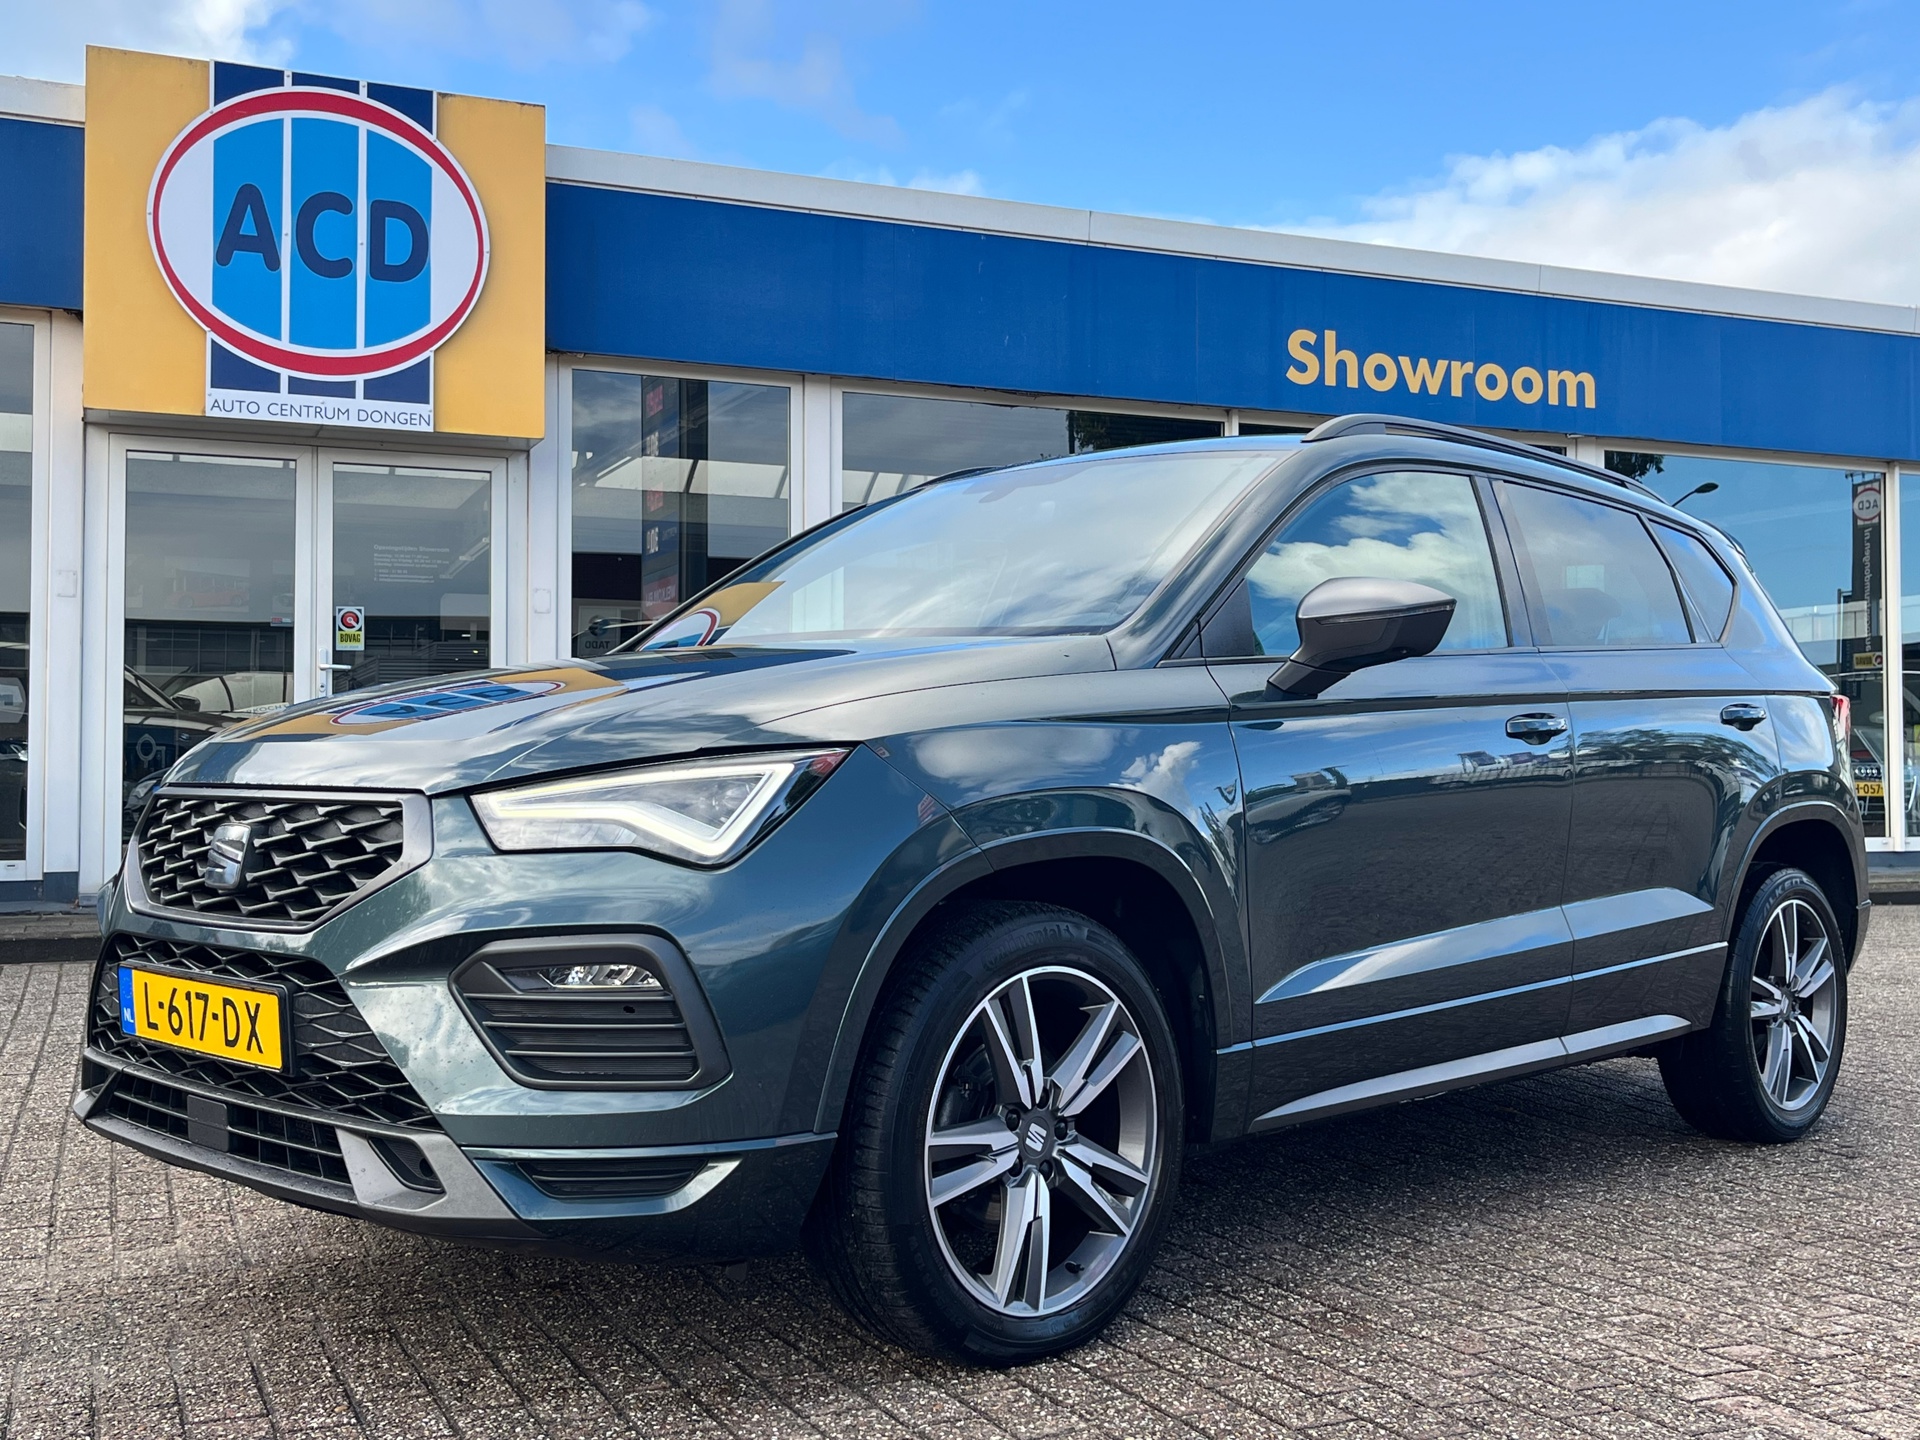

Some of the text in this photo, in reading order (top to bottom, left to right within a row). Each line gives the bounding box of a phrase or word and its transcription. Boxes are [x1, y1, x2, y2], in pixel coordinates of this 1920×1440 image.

[215, 183, 431, 283] ACD
[1285, 329, 1597, 409] Showroom
[210, 397, 431, 427] AUTO CENTRUM DONGEN
[340, 633, 361, 643] BOVAG
[123, 1007, 134, 1023] NL
[144, 981, 264, 1054] L-617-DX
